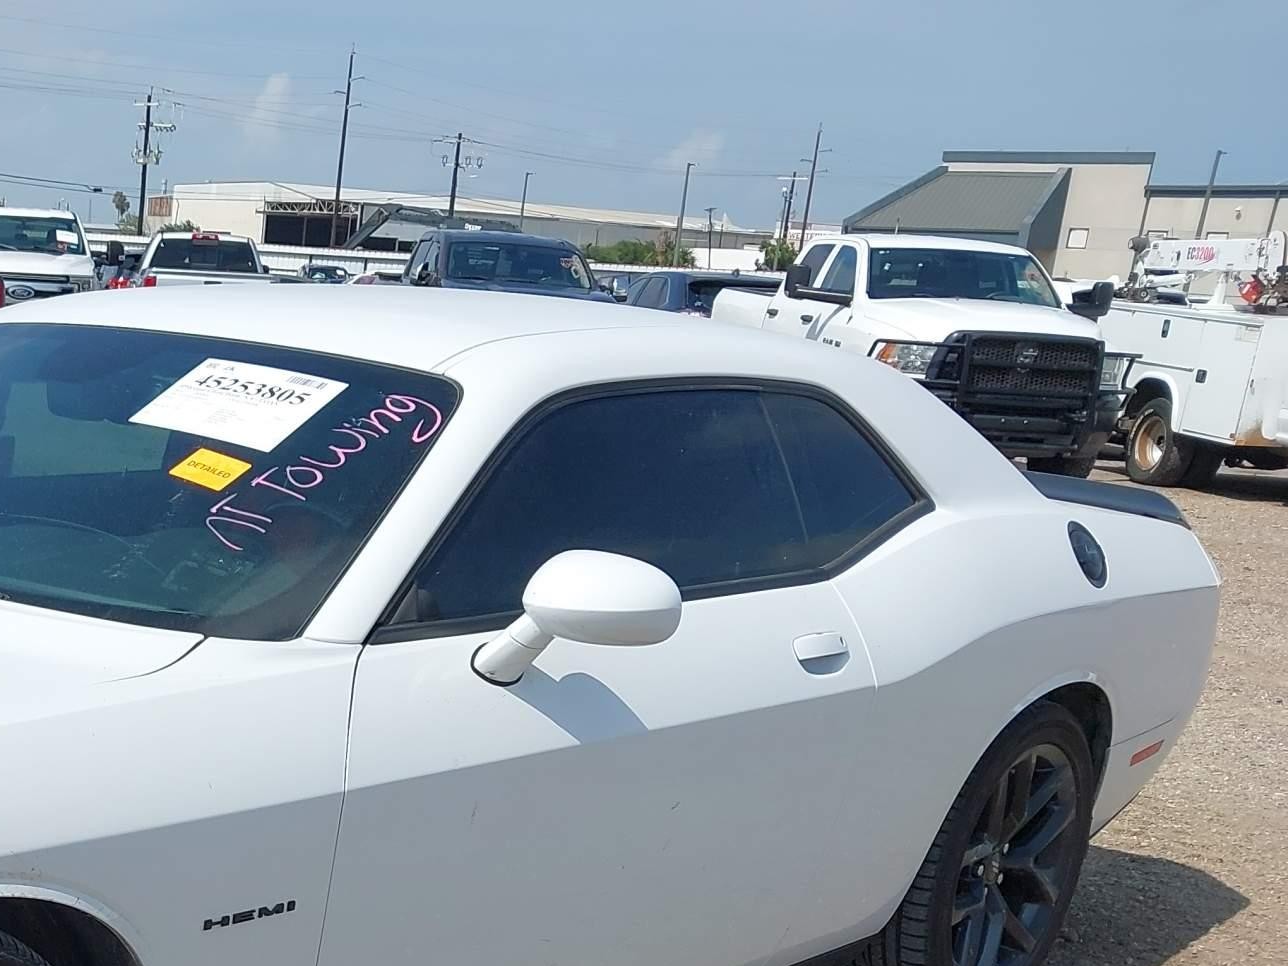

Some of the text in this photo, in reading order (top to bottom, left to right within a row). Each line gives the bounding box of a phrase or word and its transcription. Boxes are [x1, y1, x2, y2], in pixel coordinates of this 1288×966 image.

[1186, 246, 1215, 261] EC3200
[194, 373, 313, 406] 45253805
[186, 458, 232, 480] DETAILED
[202, 899, 297, 932] HEMI
